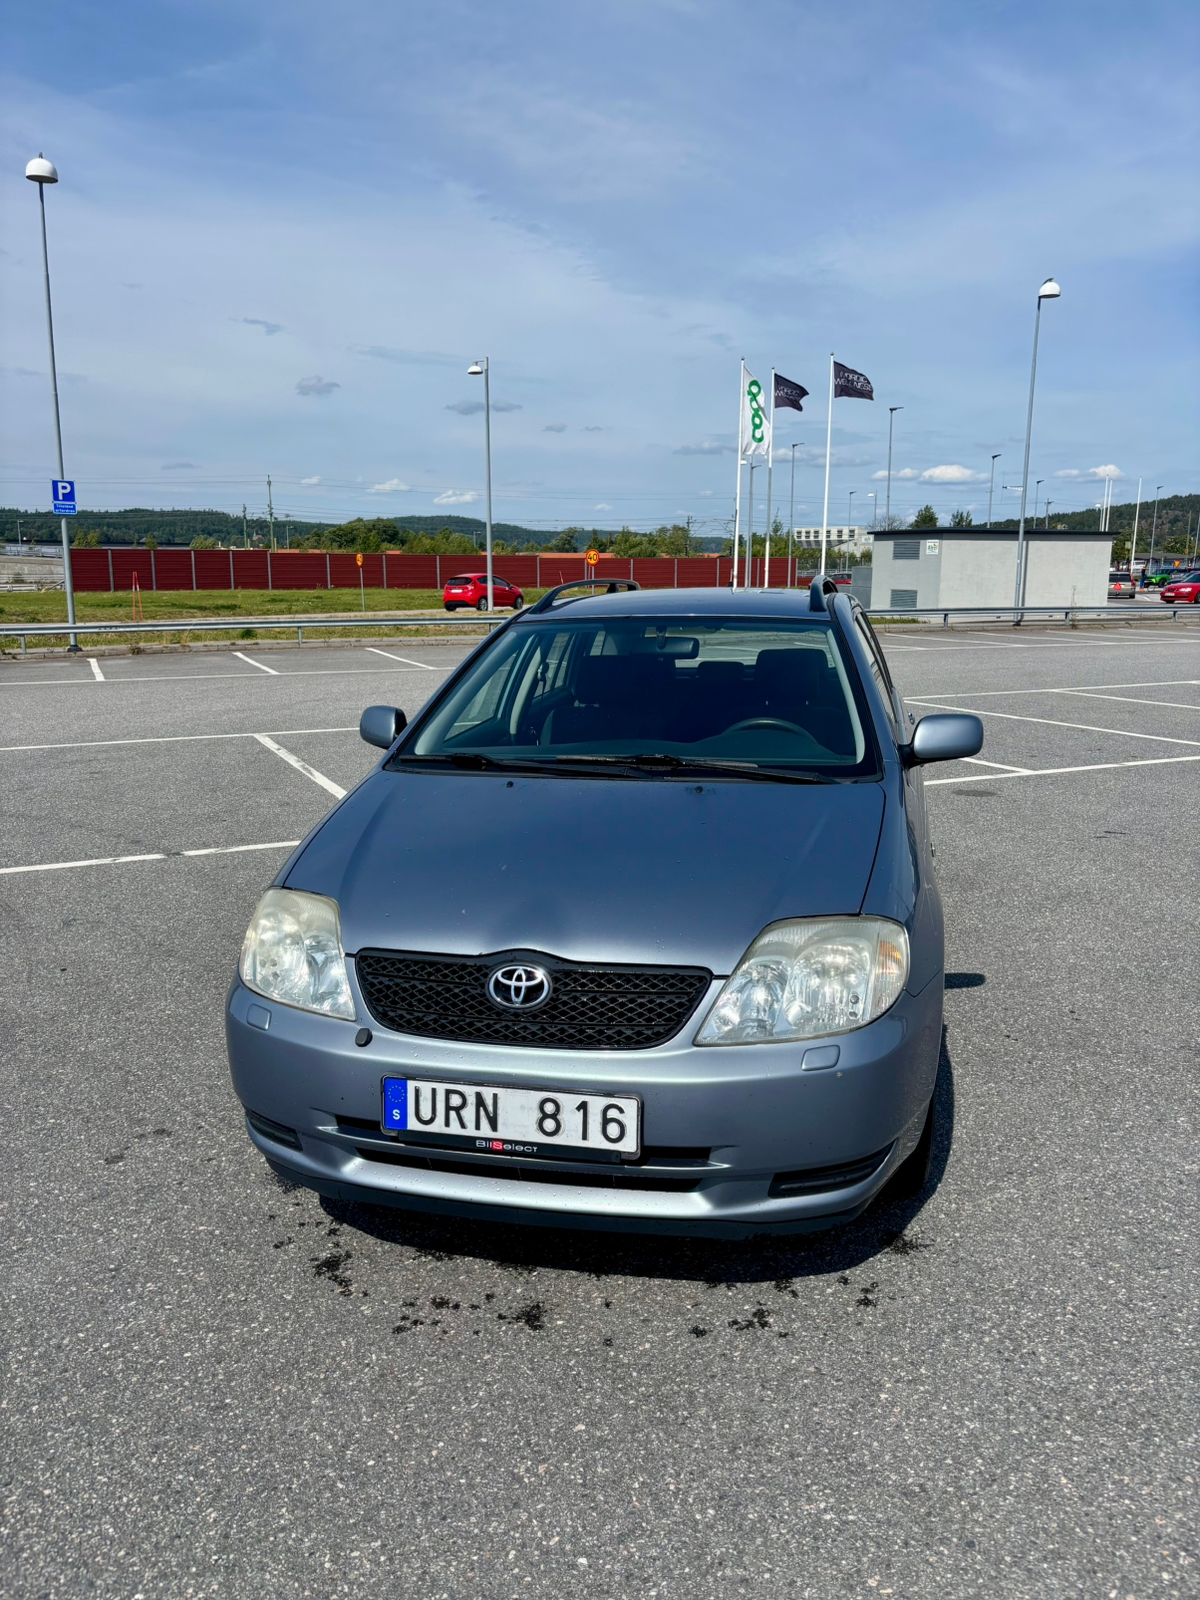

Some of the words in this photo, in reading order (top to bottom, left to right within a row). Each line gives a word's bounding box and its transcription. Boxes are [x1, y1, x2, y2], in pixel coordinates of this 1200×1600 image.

[747, 379, 765, 443] coop
[58, 482, 71, 500] P
[588, 553, 597, 561] 40
[392, 1109, 401, 1120] S
[414, 1085, 498, 1133] URN
[536, 1097, 627, 1144] 816
[476, 1140, 538, 1153] BilSelect
